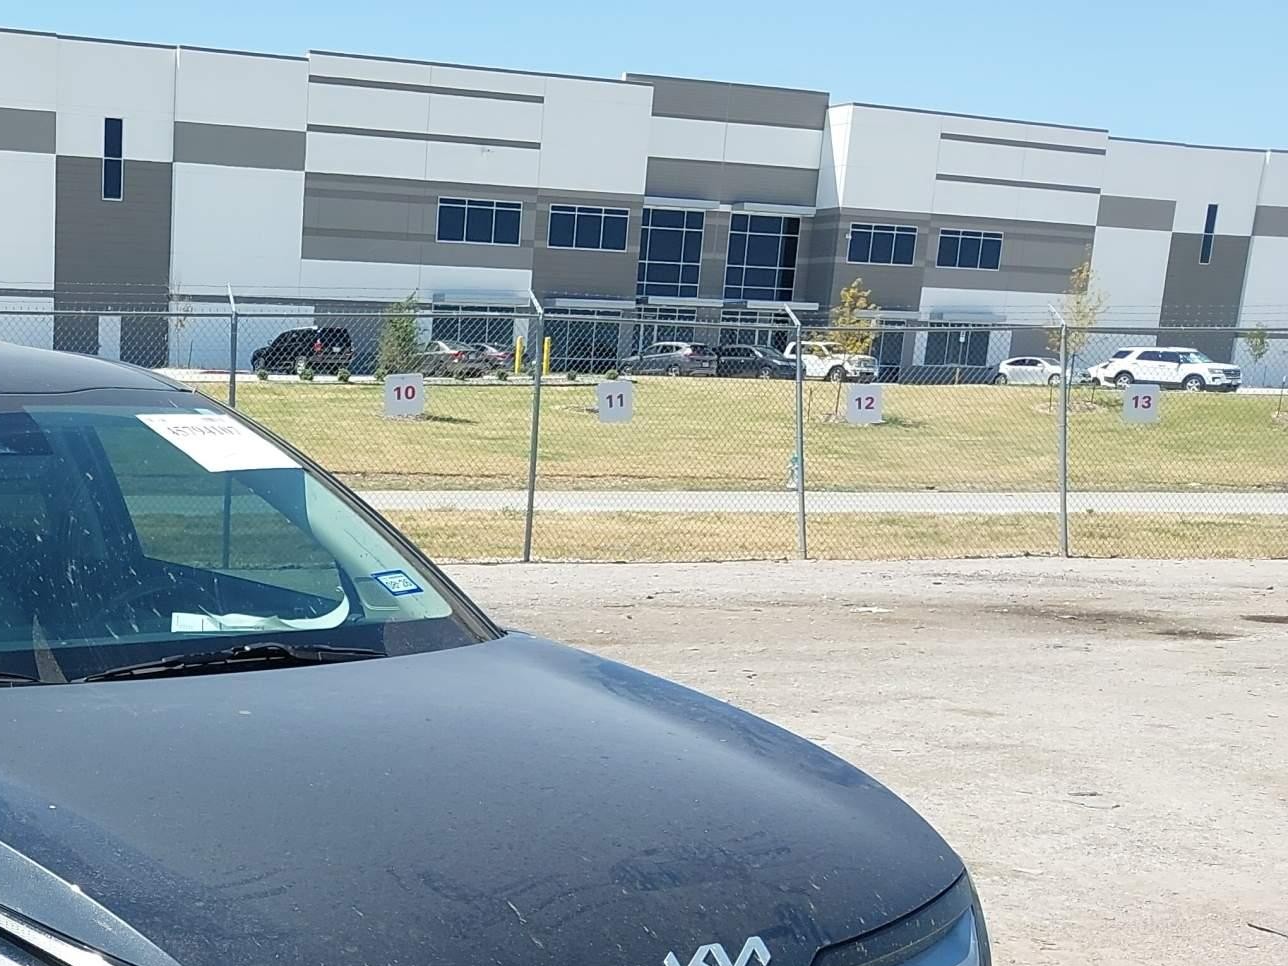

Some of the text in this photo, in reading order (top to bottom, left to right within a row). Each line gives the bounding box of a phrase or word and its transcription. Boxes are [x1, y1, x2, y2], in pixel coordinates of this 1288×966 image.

[393, 385, 416, 401] 10
[605, 393, 625, 409] 11
[854, 396, 875, 411] 12
[1131, 395, 1152, 409] 13
